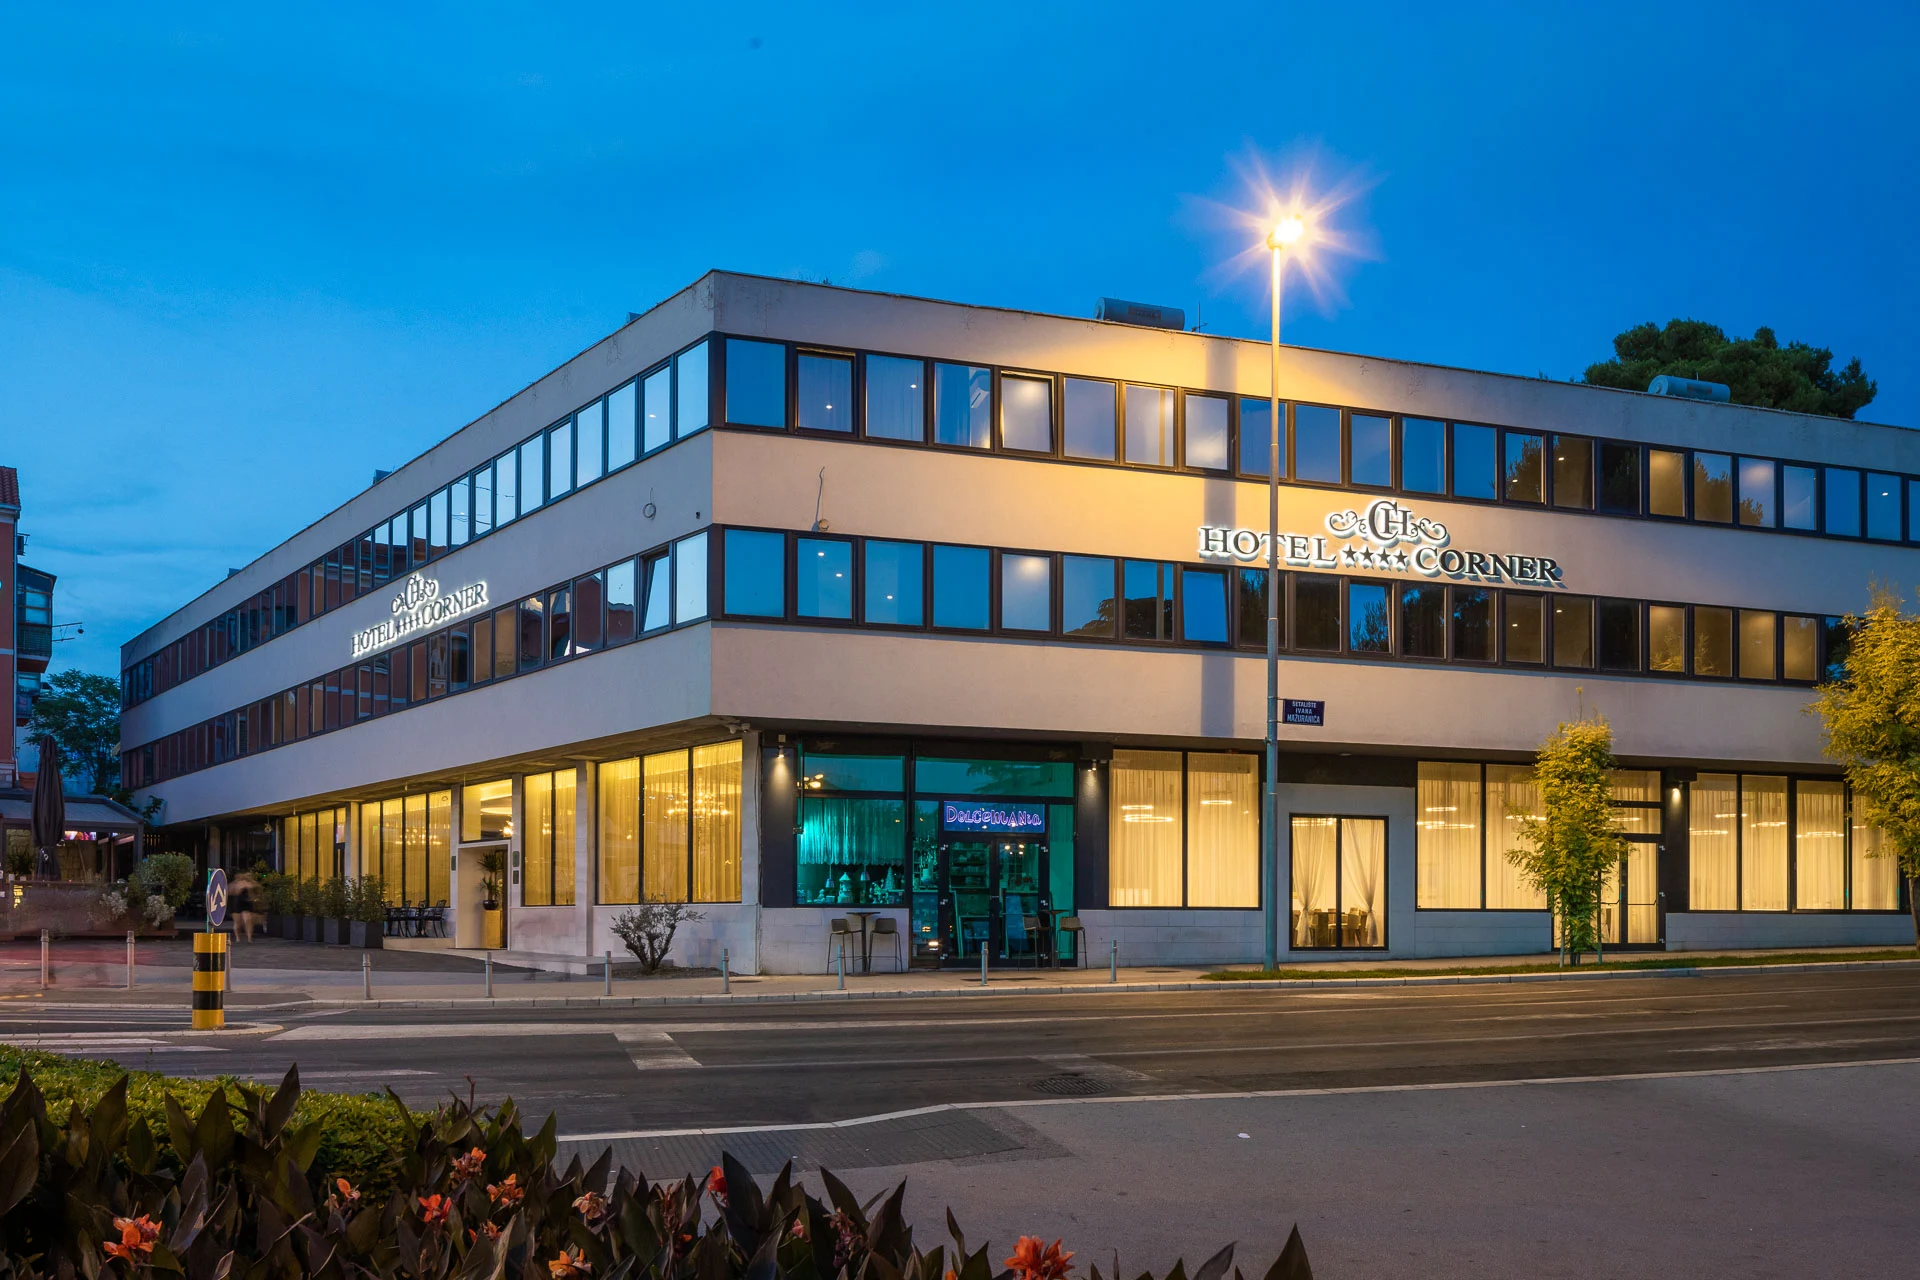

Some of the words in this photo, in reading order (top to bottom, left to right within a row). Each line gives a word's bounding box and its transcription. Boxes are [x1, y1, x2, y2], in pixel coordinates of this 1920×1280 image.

[1414, 546, 1562, 582] CORNER
[350, 620, 396, 655] HOTEL
[422, 582, 487, 625] CORNER
